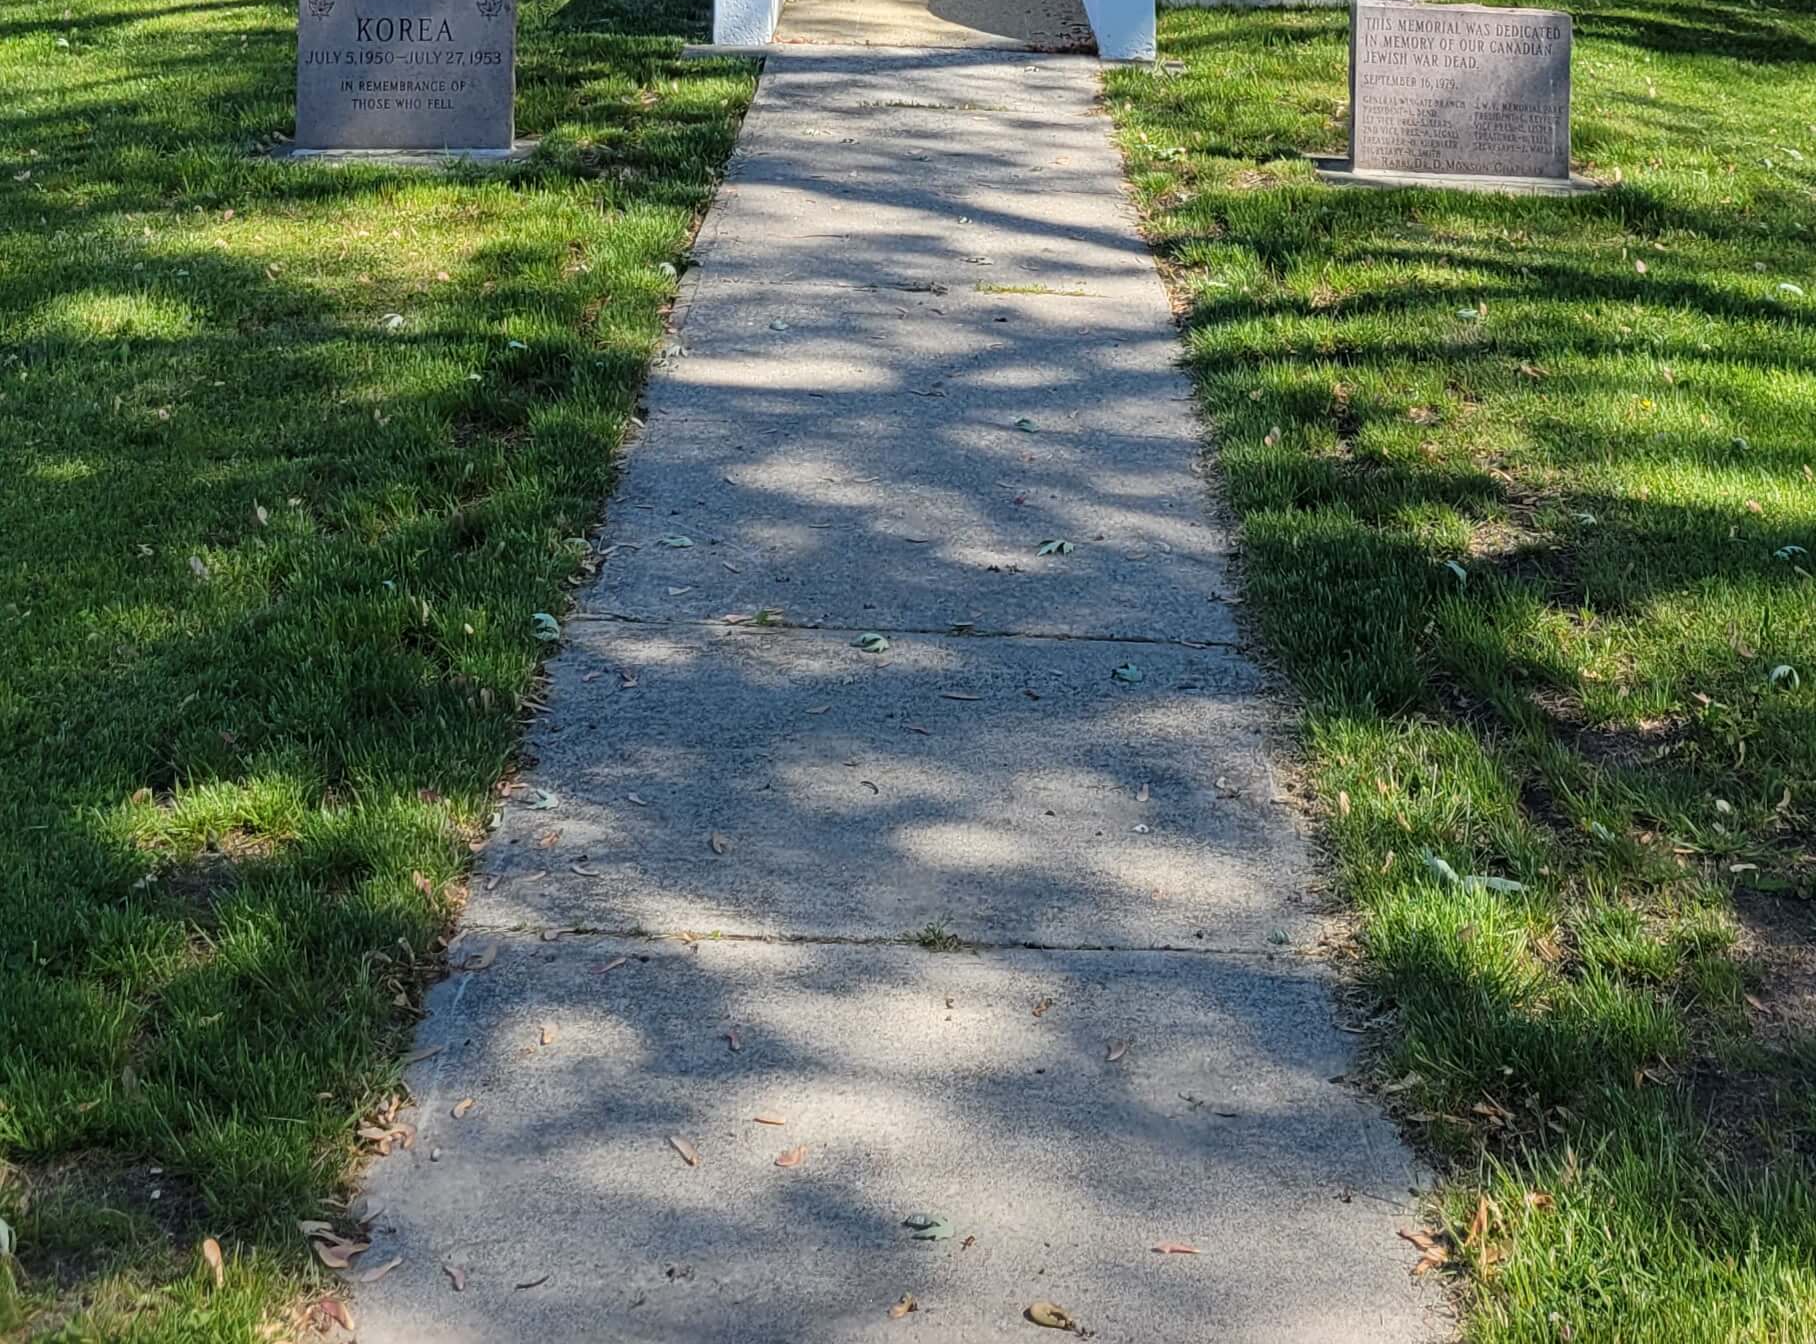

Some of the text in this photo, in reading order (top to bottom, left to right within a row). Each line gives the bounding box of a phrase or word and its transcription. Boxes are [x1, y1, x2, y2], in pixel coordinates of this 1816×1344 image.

[356, 17, 455, 42] KOREA
[1364, 16, 1561, 41] THIS MEMORIAL WAS DEDICATED
[1365, 33, 1553, 57] IN MEMORY OF OUR CANADIAN
[305, 50, 341, 65] JULY
[470, 50, 501, 65] 1953
[1363, 50, 1480, 70] JEWISH WAR DEAD.
[341, 79, 466, 92] IN REMEMBRANCE OF
[1363, 74, 1417, 87] SEPTEMBER
[352, 98, 454, 110] THOSE WHO FELL
